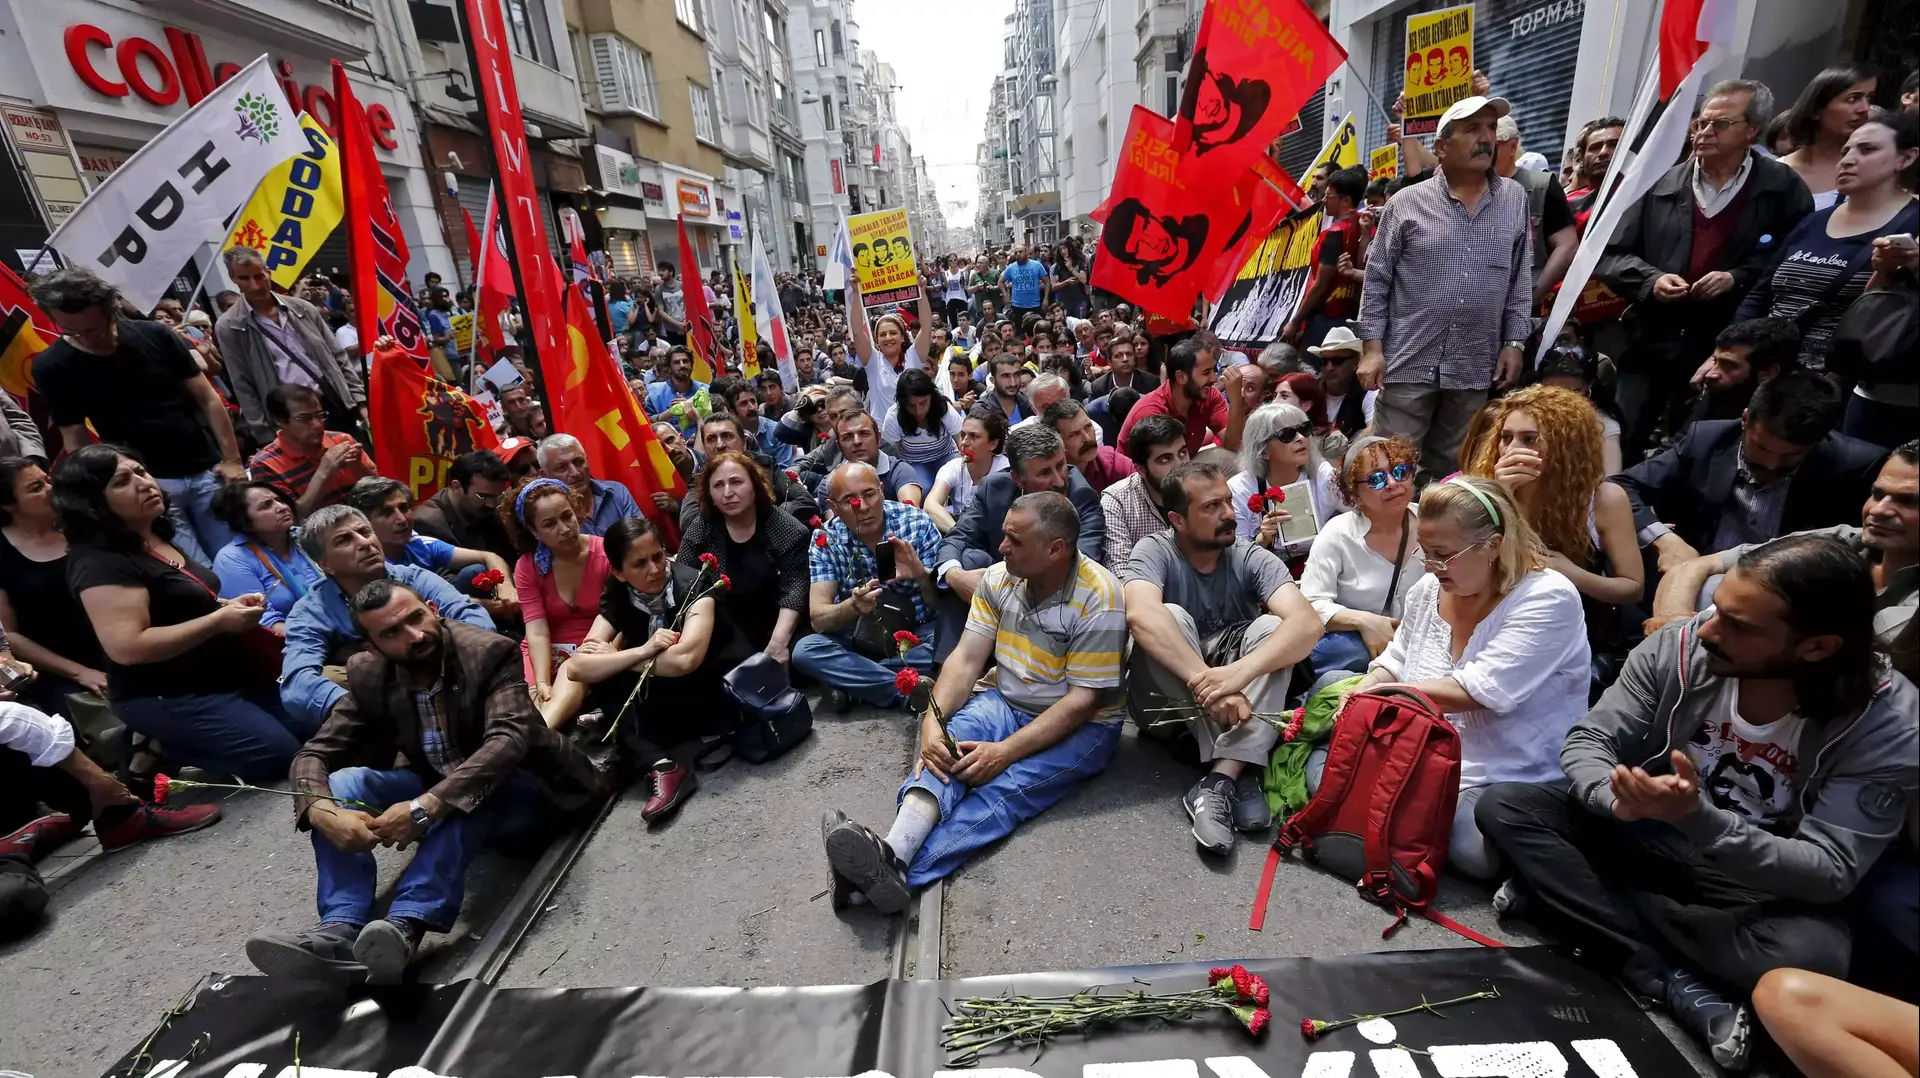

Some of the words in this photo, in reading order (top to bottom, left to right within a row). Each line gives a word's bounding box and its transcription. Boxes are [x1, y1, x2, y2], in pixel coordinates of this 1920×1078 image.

[25, 131, 52, 142] NO:53
[97, 139, 231, 268] HDP
[266, 127, 329, 272] SODAP
[888, 269, 916, 283] OLACAK
